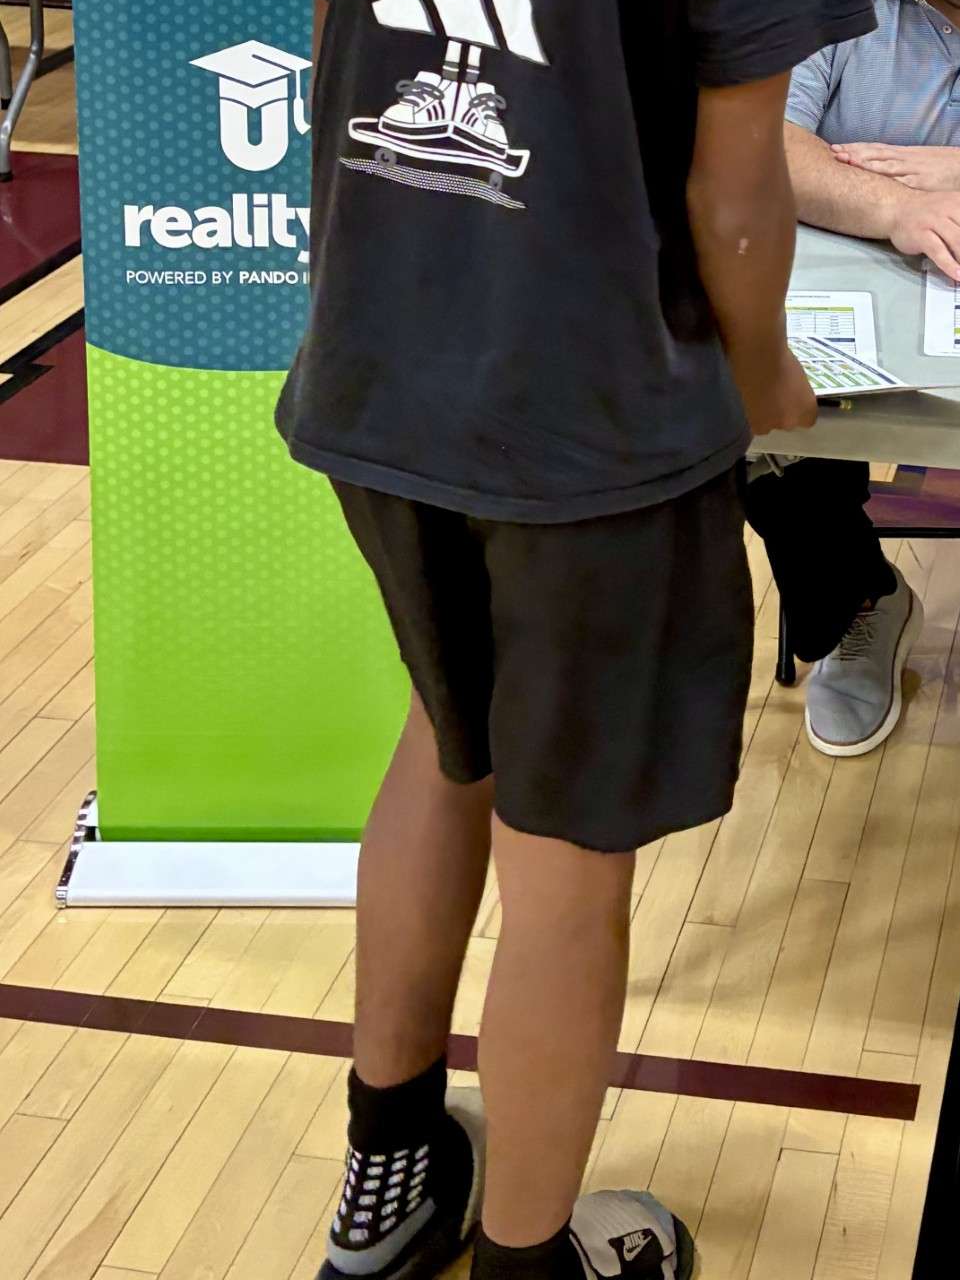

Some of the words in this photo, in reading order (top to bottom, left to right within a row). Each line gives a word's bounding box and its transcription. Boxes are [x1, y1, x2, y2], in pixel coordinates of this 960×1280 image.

[126, 270, 207, 285] POWERED
[212, 271, 233, 285] BY
[239, 271, 299, 285] PANDO
